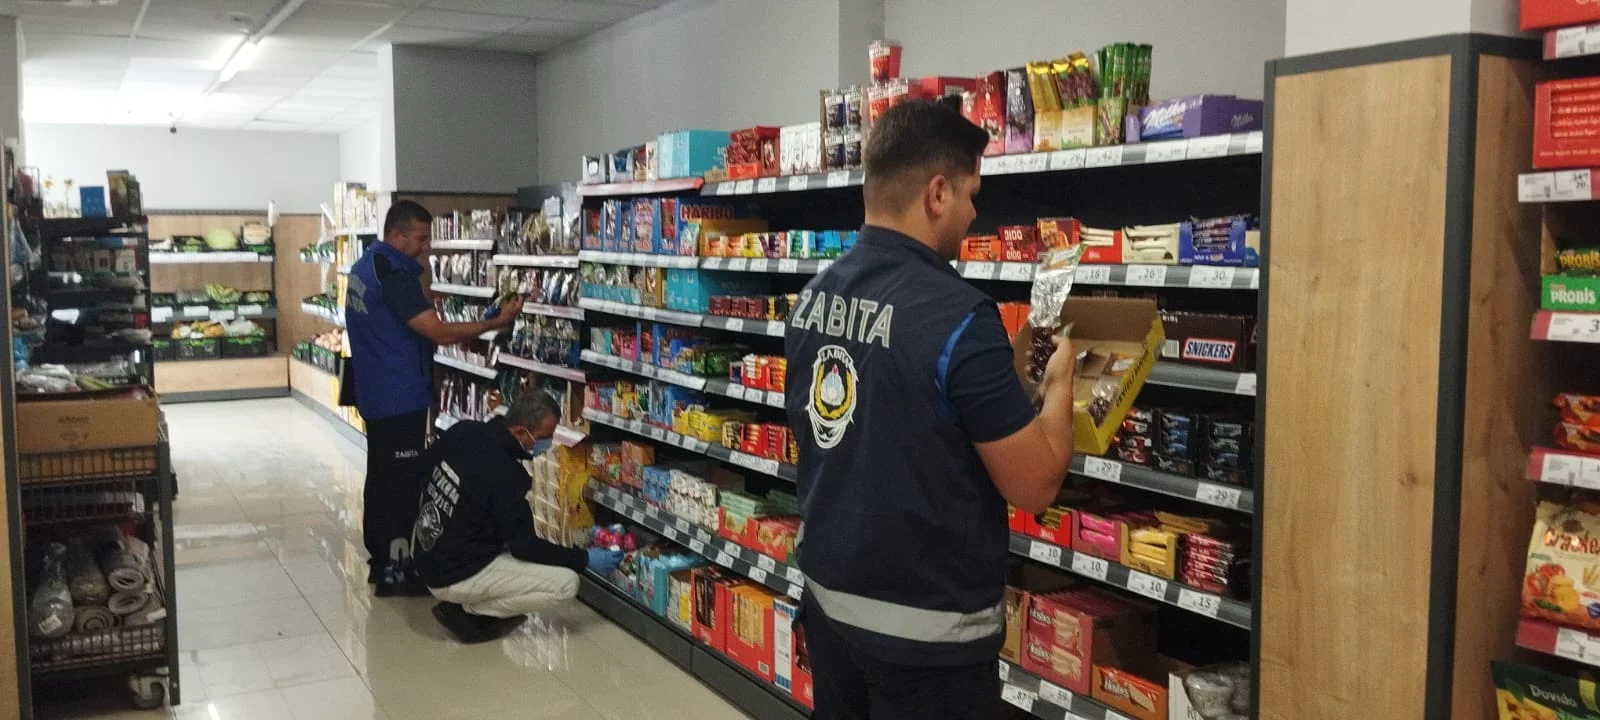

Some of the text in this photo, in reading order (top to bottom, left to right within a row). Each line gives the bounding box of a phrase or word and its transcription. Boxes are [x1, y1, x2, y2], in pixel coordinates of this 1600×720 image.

[1143, 100, 1186, 129] Milka
[680, 203, 735, 222] HARIBO
[791, 288, 894, 349] ZABITA
[1185, 341, 1233, 359] SNICKERS
